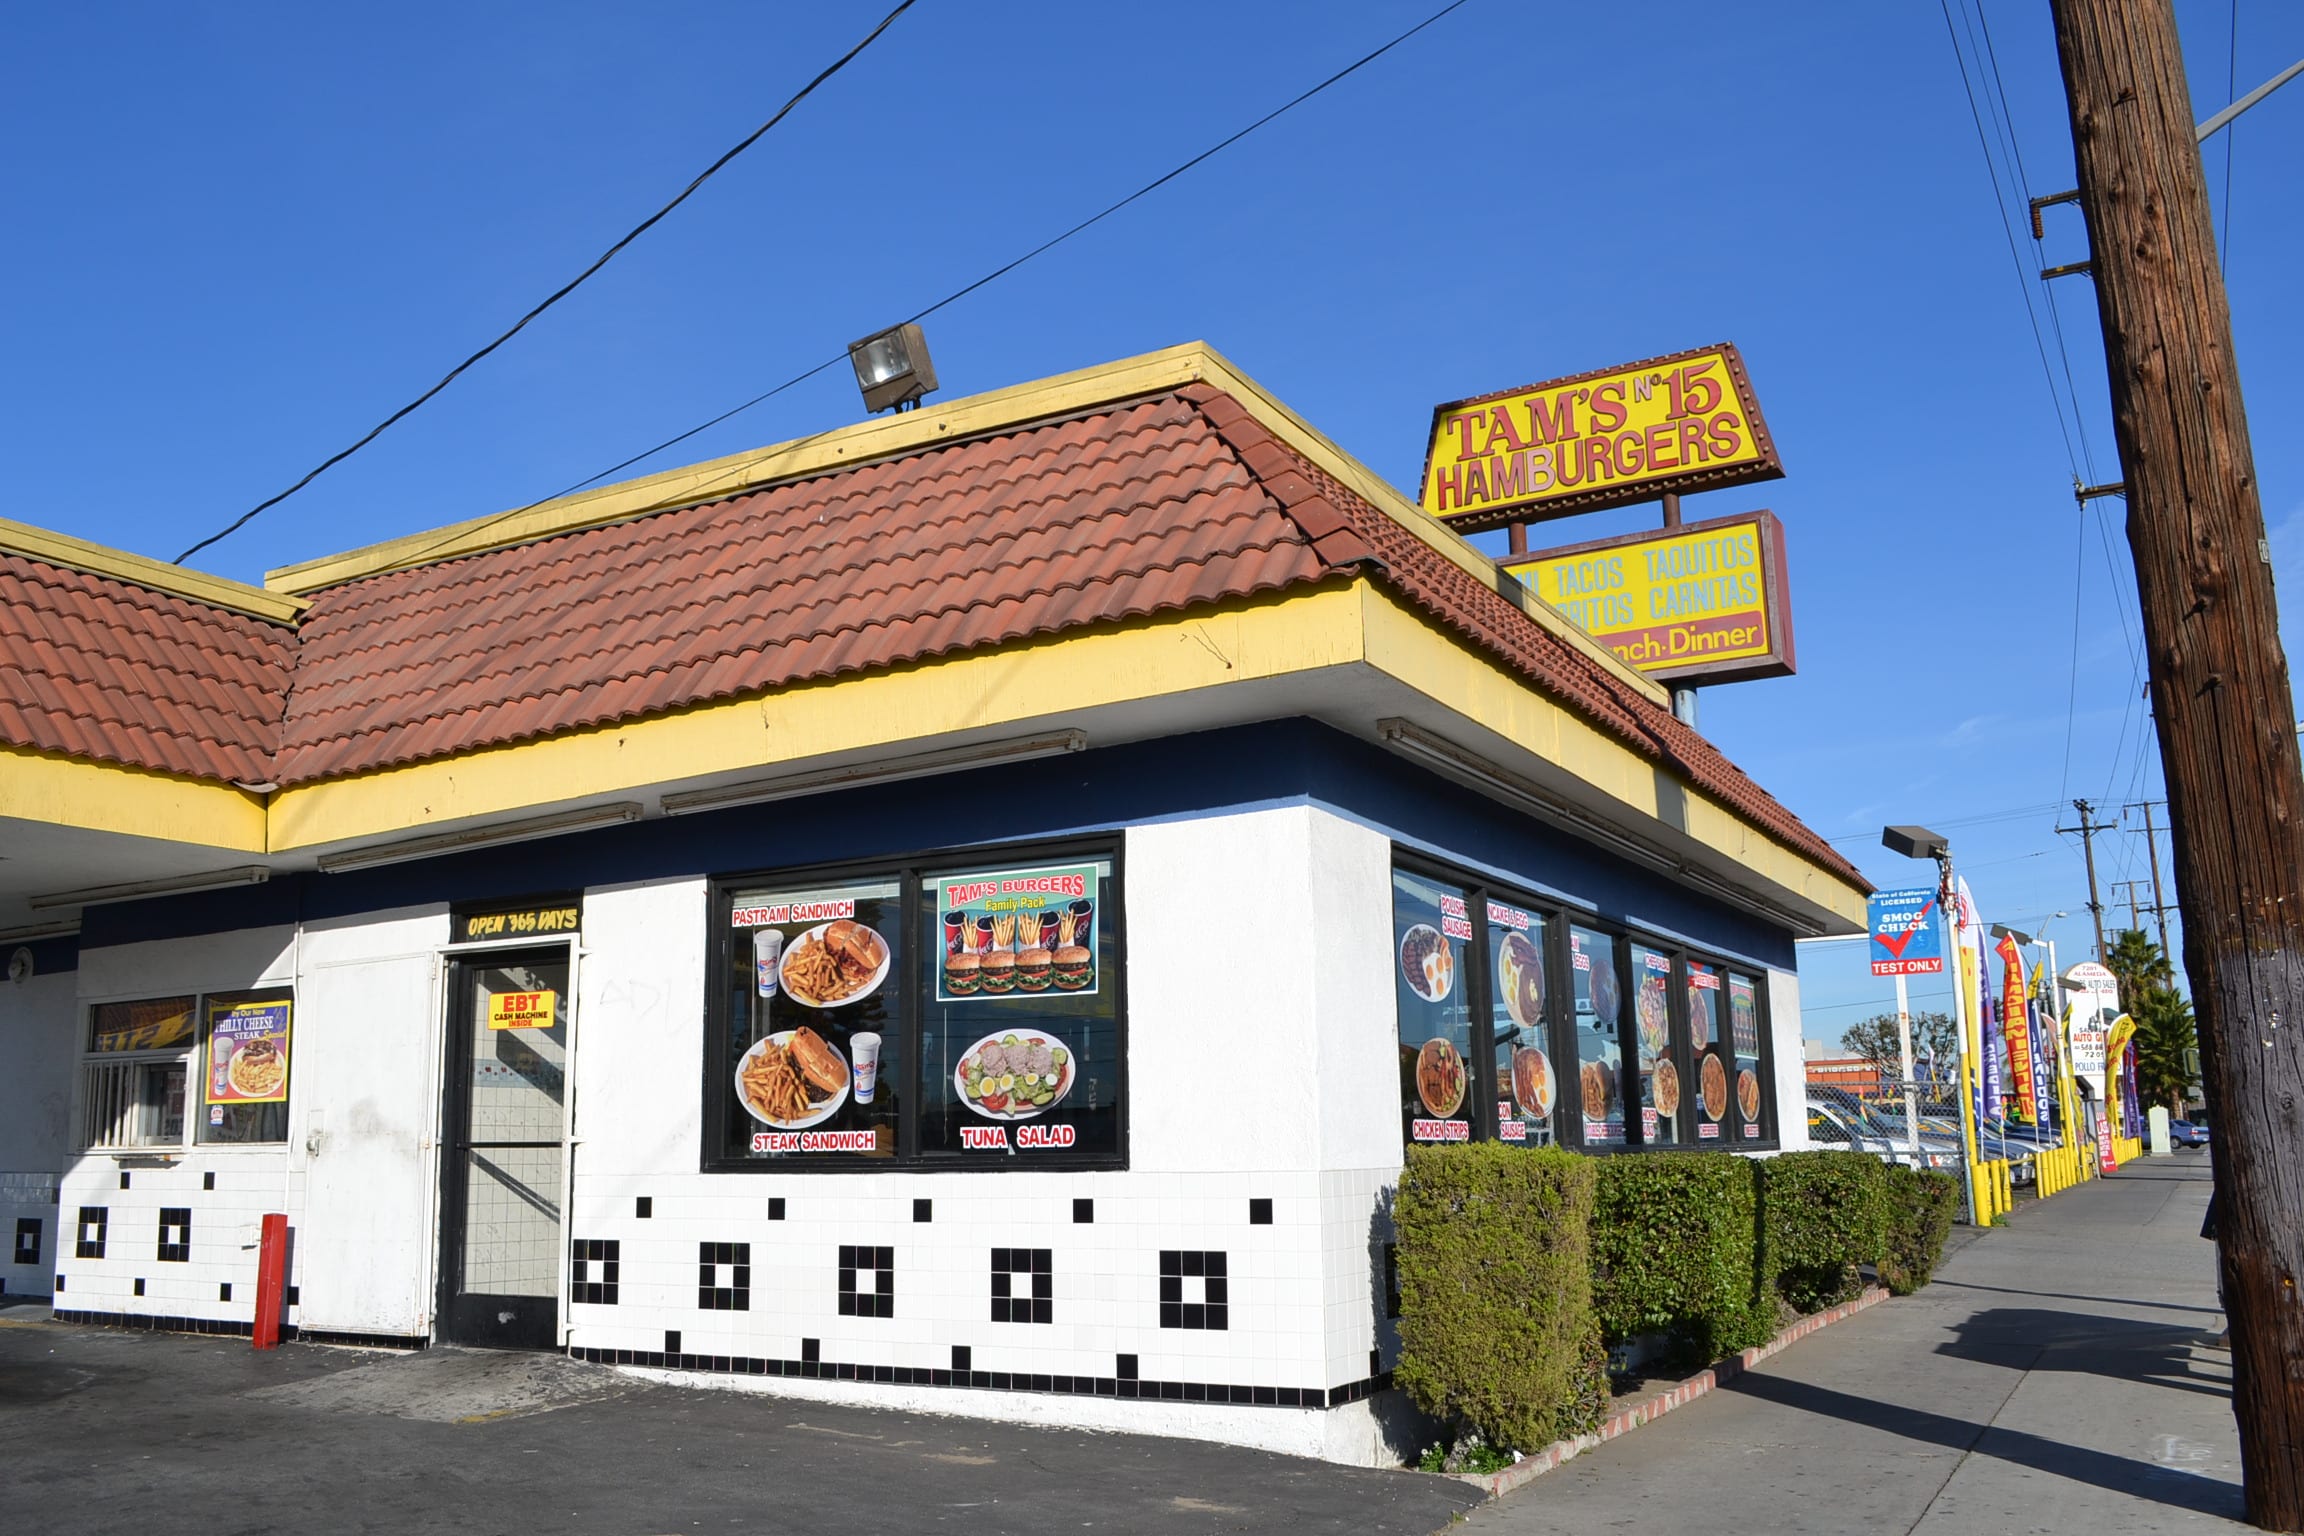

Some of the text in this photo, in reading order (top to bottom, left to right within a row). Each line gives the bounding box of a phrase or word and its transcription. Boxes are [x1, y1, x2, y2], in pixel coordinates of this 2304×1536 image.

[1446, 382, 1627, 462] TAM'S
[1662, 360, 1722, 420] 15
[1437, 411, 1742, 511] HAMBURGERS
[1553, 557, 1625, 597] TACOS
[1642, 534, 1755, 583] TAQUITOS
[1649, 573, 1758, 620] CARNITAS
[947, 874, 1085, 908] TAM'S BURGERS
[985, 896, 1046, 913] Family Pack
[1881, 897, 1923, 906] LICENSED
[733, 900, 854, 926] PASTRAMI SANDWICH
[1882, 911, 1923, 922] SMOG
[468, 908, 578, 936] OPEN 365 DAYS
[1878, 921, 1930, 933] CHECK
[1872, 960, 1940, 974] TEST ONLY
[503, 994, 541, 1012] EBT
[243, 1016, 274, 1031] CHEESE
[494, 1011, 548, 1021] CASH MACHINE
[508, 1019, 533, 1027] INSIDE
[234, 1031, 260, 1040] STEAK
[2074, 1033, 2092, 1042] AUTO
[2074, 1061, 2096, 1072] POLLO
[962, 1126, 1074, 1147] TUNA SALAD
[1413, 1121, 1469, 1140] CHICKEN STRIPS
[753, 1132, 875, 1150] STEAK SANDWICH
